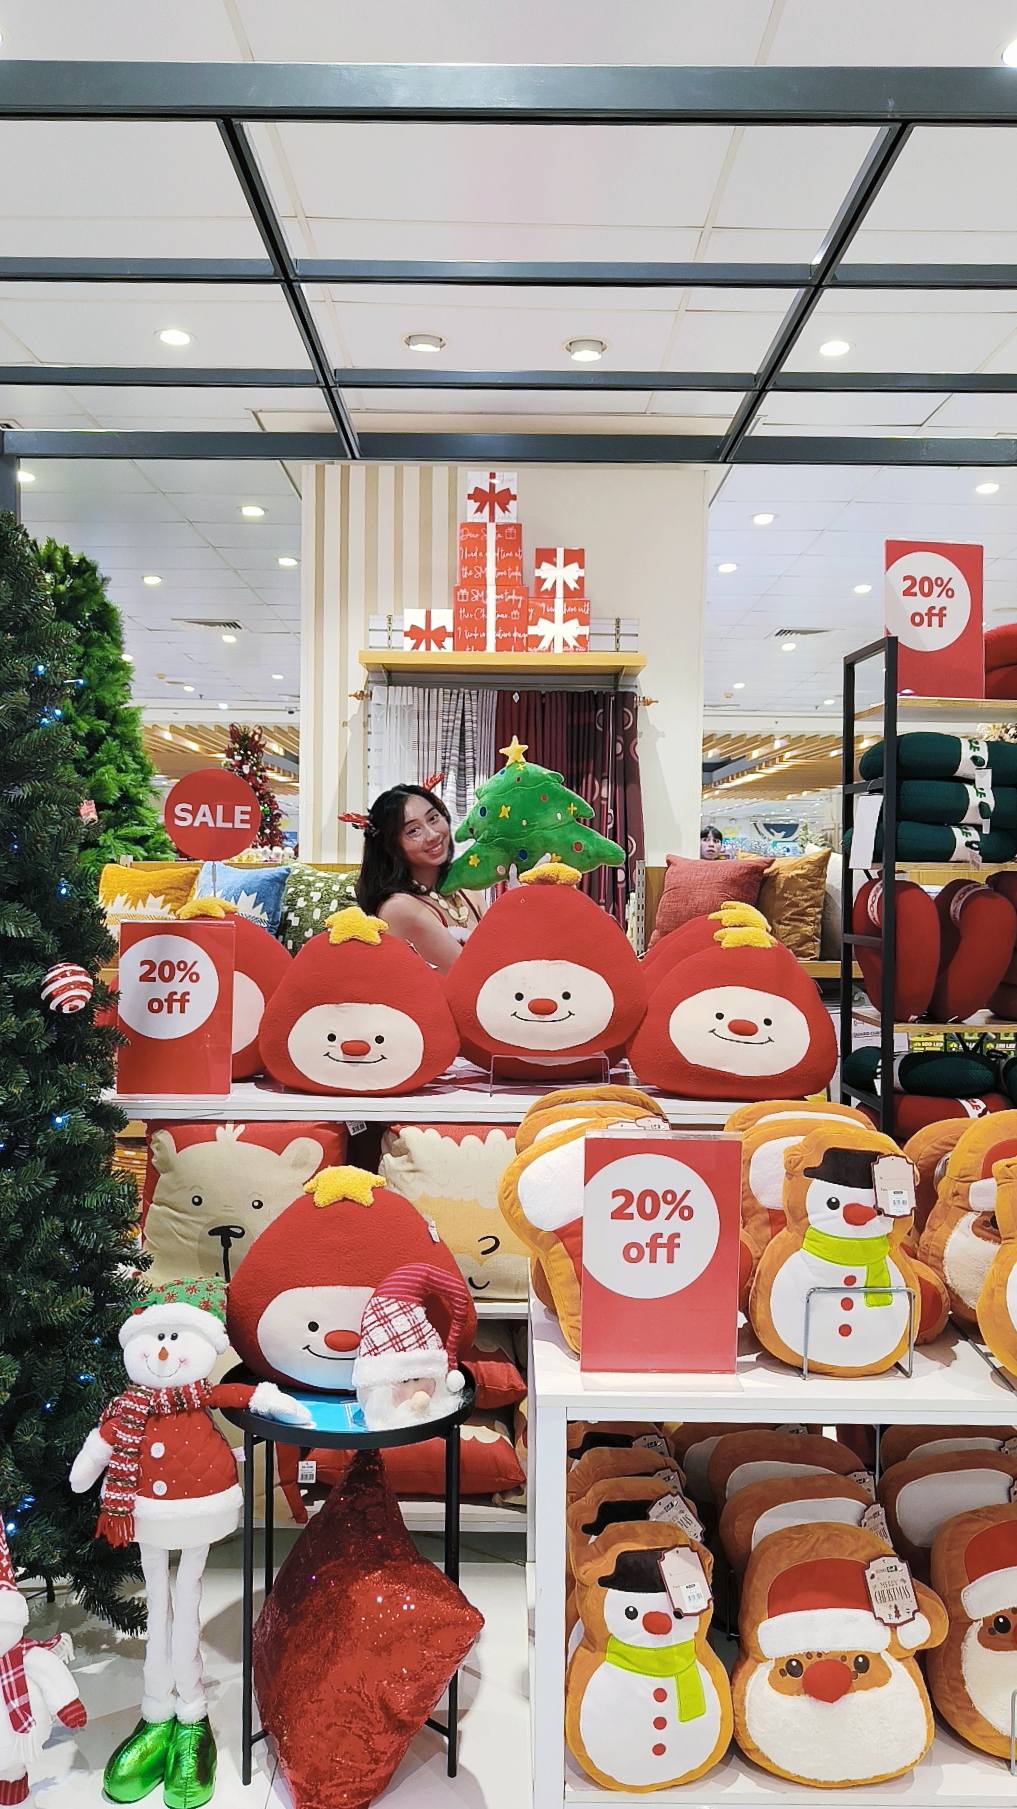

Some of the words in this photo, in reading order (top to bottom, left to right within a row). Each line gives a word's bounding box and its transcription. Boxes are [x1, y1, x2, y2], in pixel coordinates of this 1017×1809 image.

[902, 575, 955, 599] 20%
[910, 606, 947, 628] off
[174, 803, 252, 829] SALE
[138, 960, 201, 984] 20%
[147, 991, 190, 1014] off
[609, 1188, 695, 1222] 20%
[621, 1232, 681, 1264] off
[874, 1585, 911, 1604] CHRISTMAS
